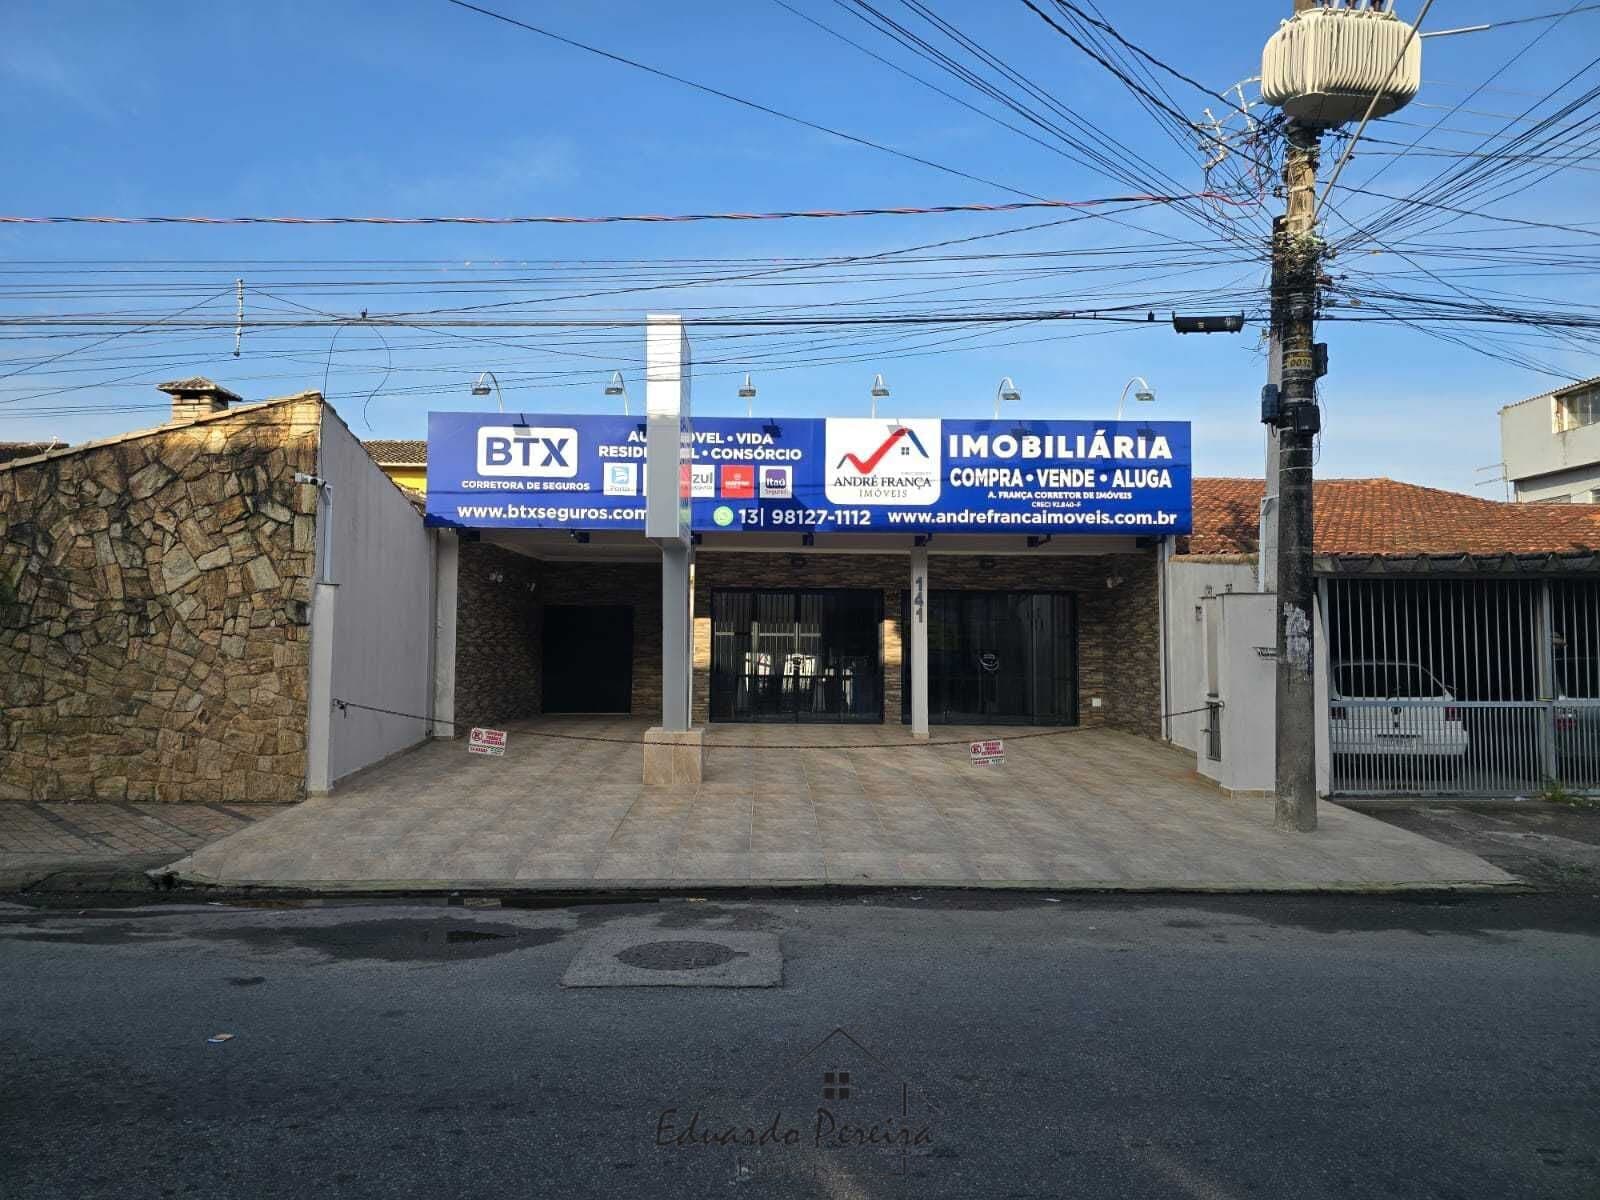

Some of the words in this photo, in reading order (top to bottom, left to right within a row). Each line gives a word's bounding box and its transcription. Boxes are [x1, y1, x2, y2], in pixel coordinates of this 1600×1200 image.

[628, 431, 725, 445] AUVEL
[736, 432, 774, 445] VIDA
[949, 430, 1173, 459] IMOBILIÁRIA
[485, 437, 569, 467] BTX
[598, 446, 700, 460] RESIDL
[711, 446, 802, 461] CONSÓRCIO
[461, 480, 525, 490] CORRETORA
[526, 481, 541, 490] DE
[543, 481, 591, 491] SEGUROS
[834, 474, 878, 487] ANDRÉ
[881, 476, 932, 490] FRANÇA
[950, 468, 1023, 489] COMPRA
[1037, 469, 1095, 489] VENDE
[1112, 470, 1172, 489] ALUGA
[859, 488, 908, 498] IMÓVEIS
[987, 491, 997, 499] A.
[998, 491, 1033, 501] FRANÇA
[1034, 491, 1082, 499] CORRETOR
[1083, 491, 1095, 499] DE
[1096, 490, 1132, 500] IMÓVEIS
[772, 509, 871, 525] 98127-1112
[887, 506, 1177, 526] www.andrefrancaimoveis.com.br
[914, 576, 924, 623] 141
